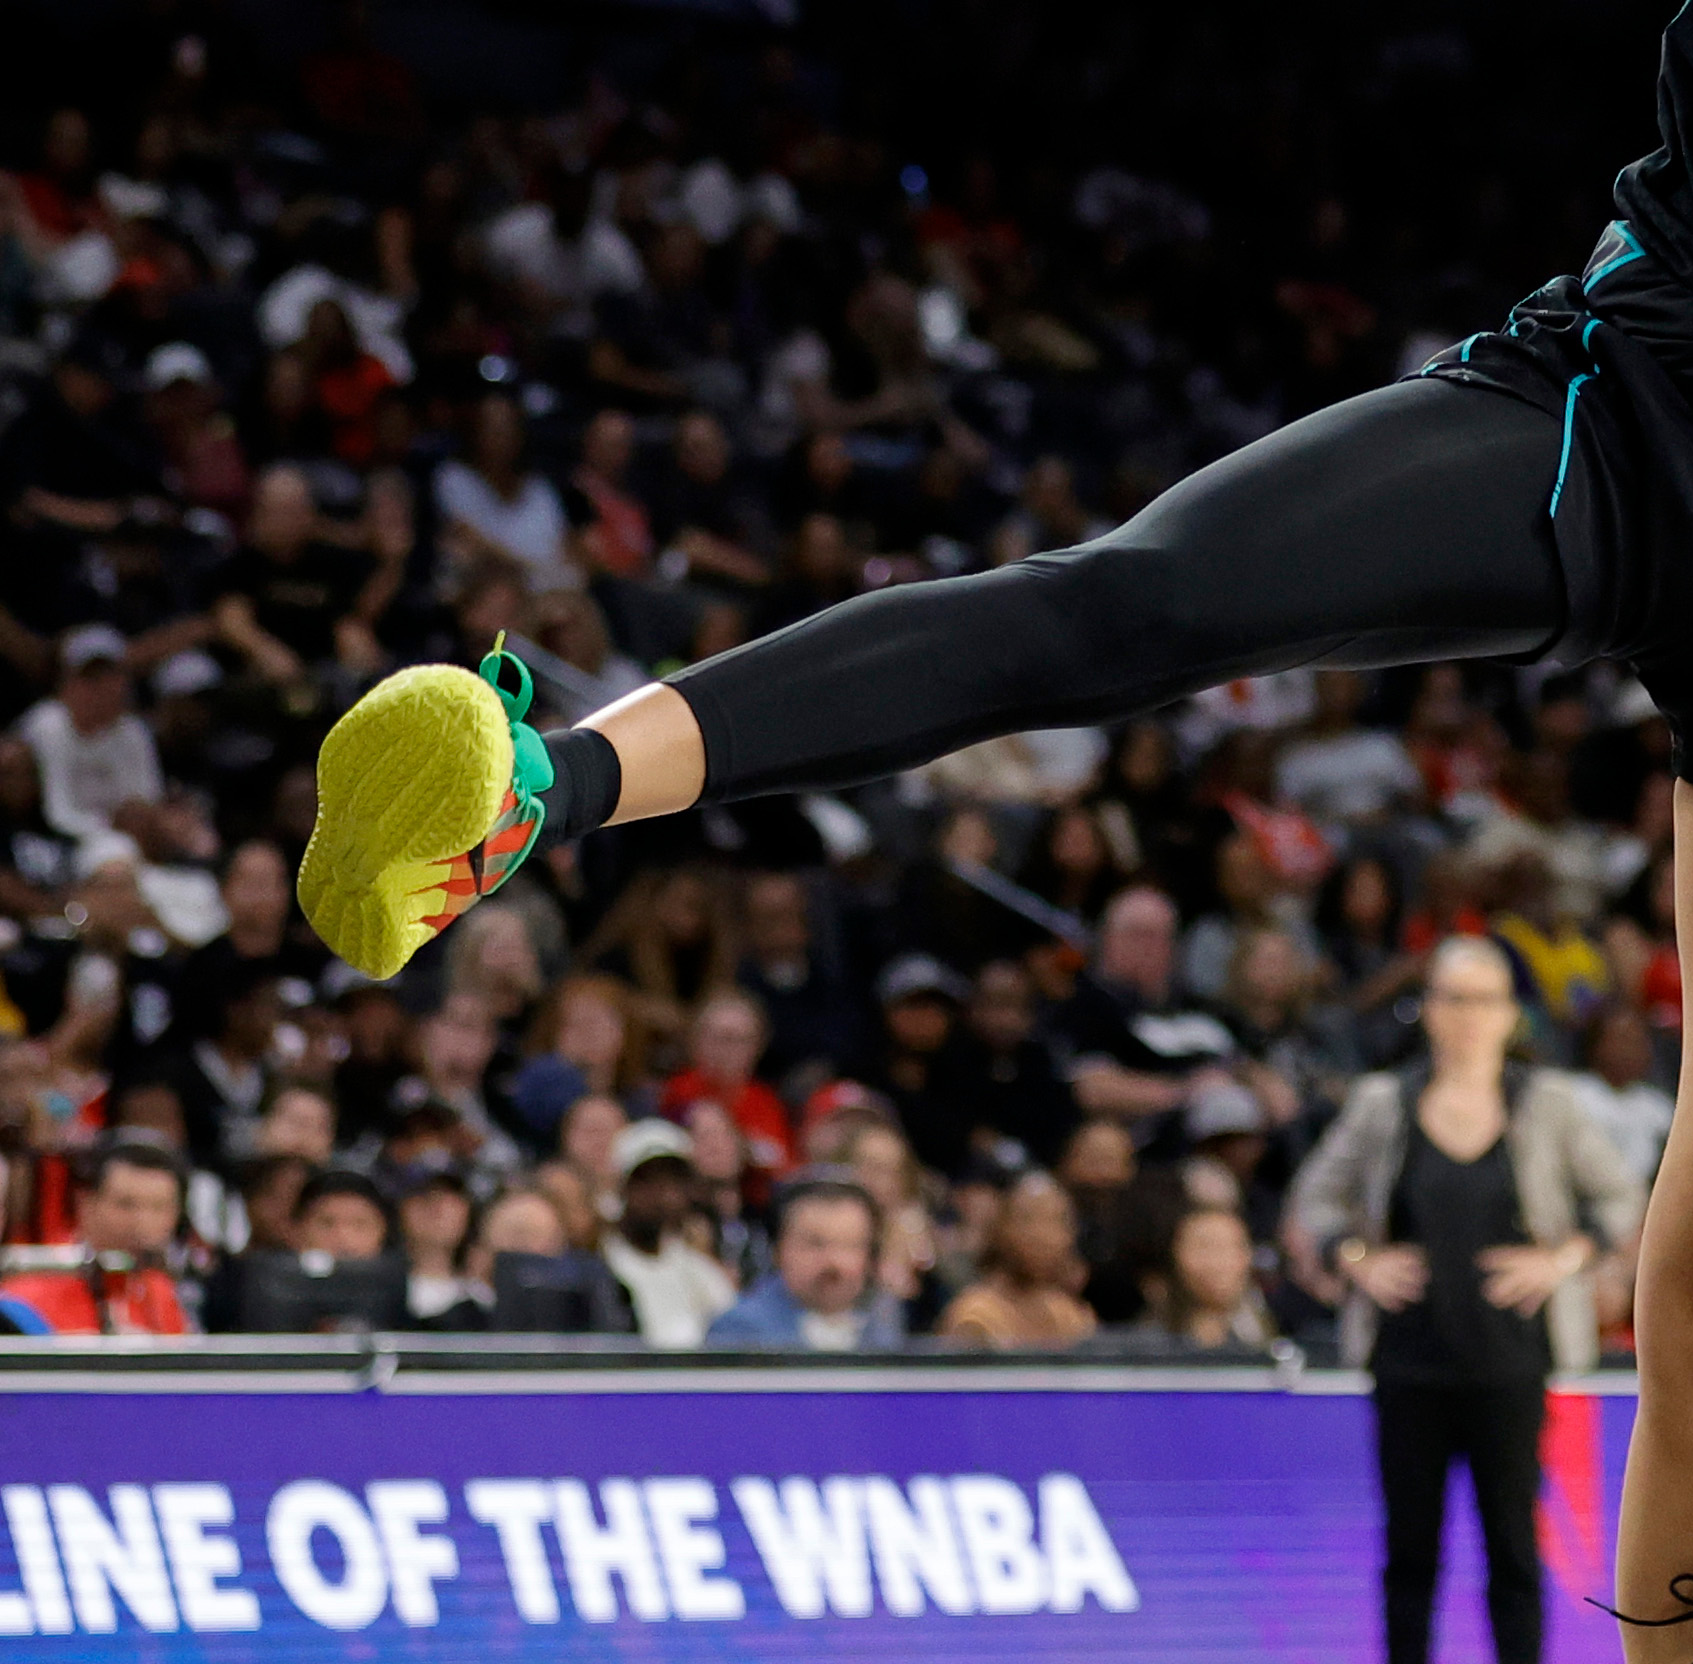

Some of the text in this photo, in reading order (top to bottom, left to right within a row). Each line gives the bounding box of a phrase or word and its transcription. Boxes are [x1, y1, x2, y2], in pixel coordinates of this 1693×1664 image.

[266, 1478, 460, 1631] OF
[466, 1475, 745, 1624] THE
[732, 1471, 1140, 1620] WNBA
